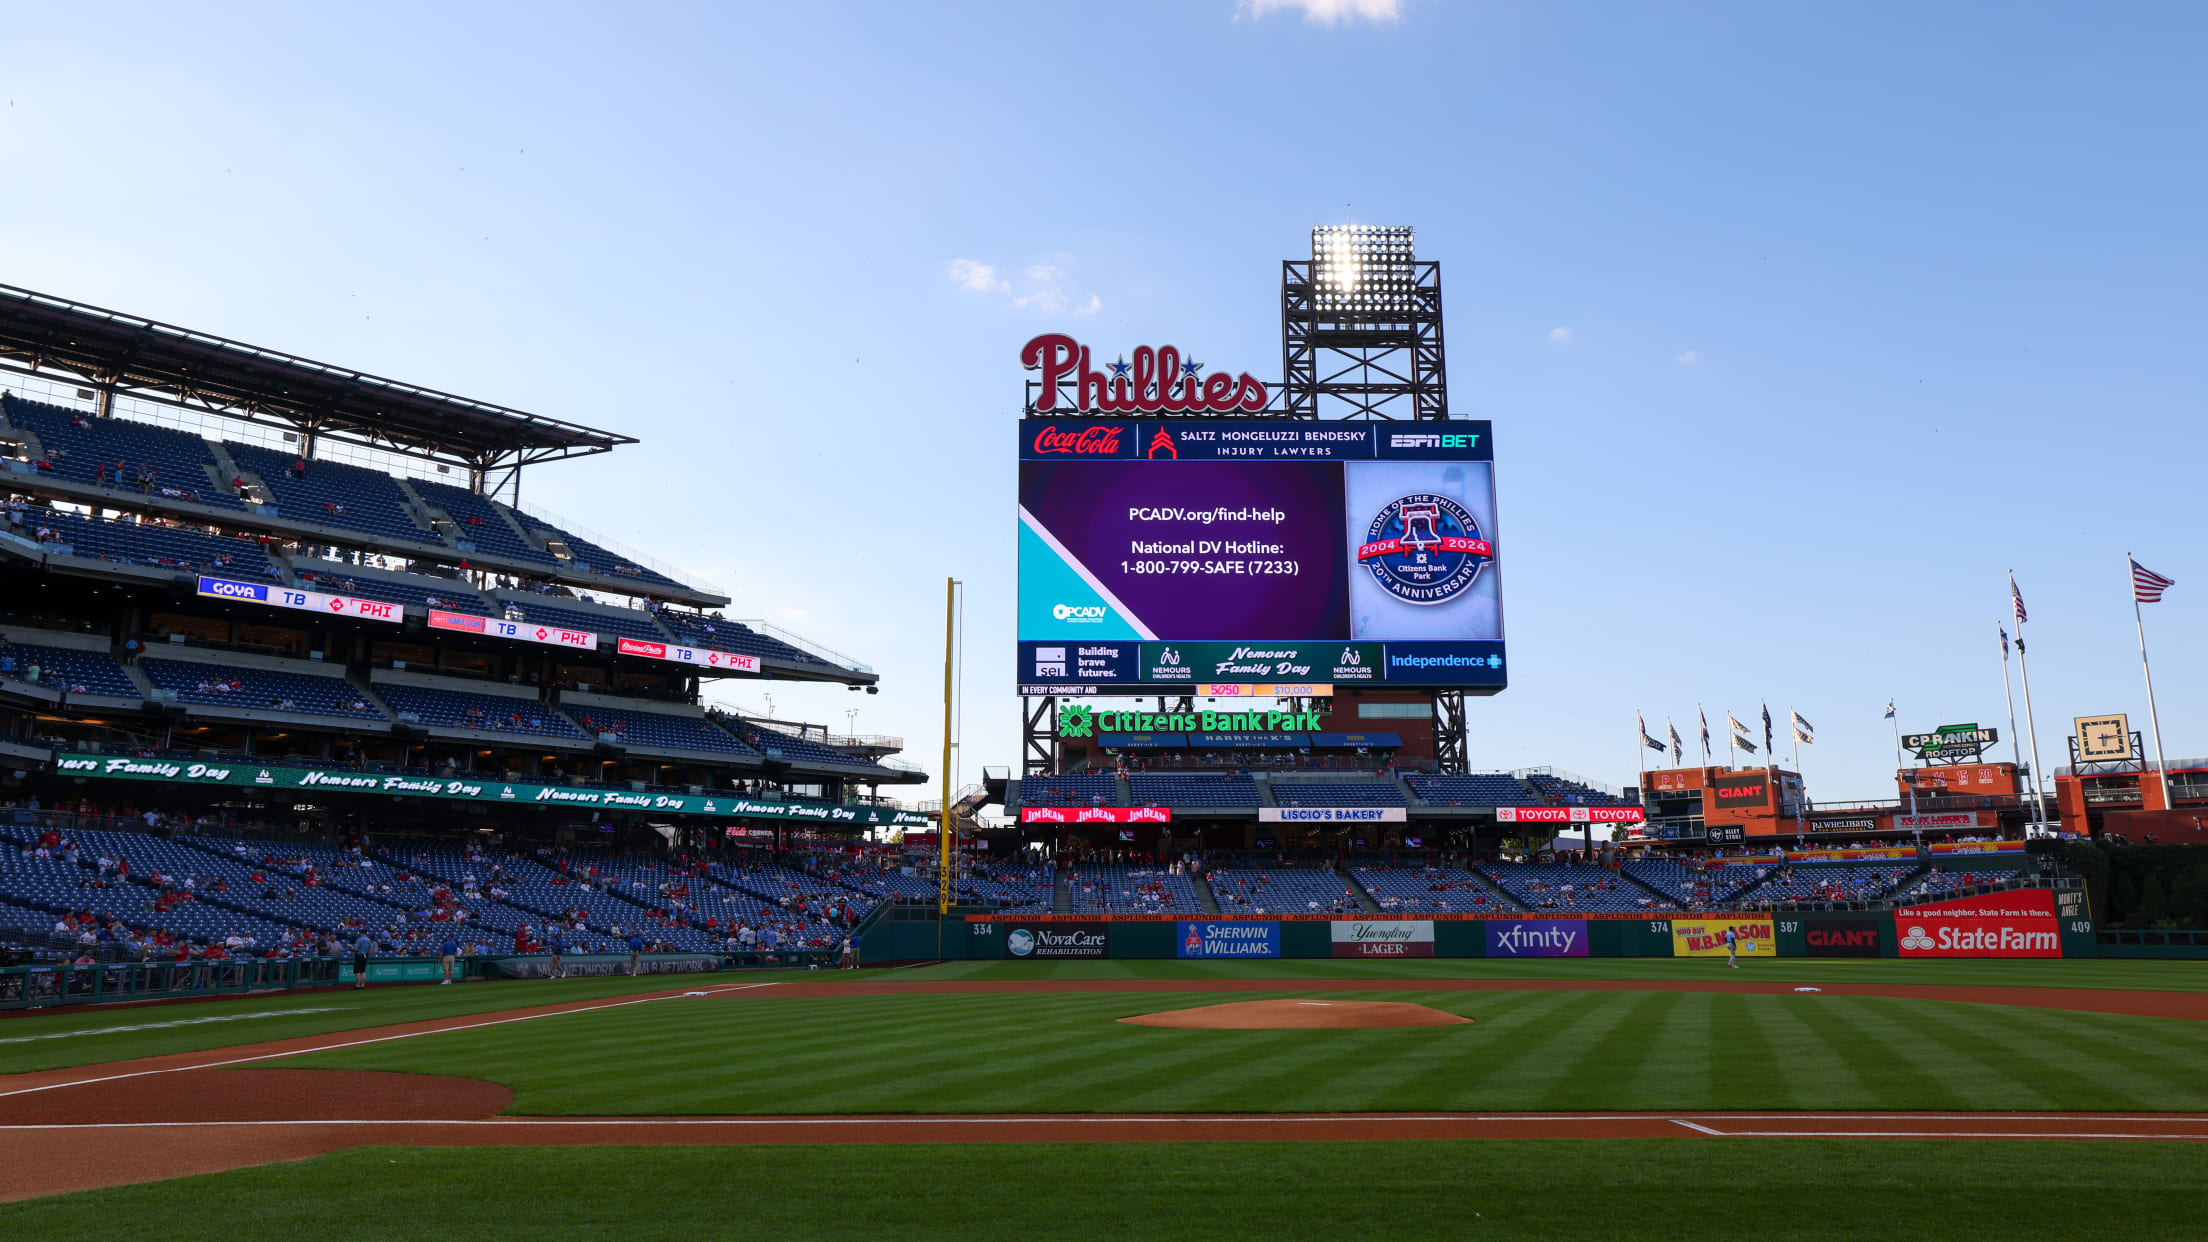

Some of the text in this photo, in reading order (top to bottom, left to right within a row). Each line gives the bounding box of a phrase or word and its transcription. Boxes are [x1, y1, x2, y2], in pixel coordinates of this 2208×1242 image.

[1020, 333, 1268, 415] Phillies
[1034, 426, 1124, 453] Coca-Cola
[1181, 431, 1366, 441] SALTZ MONGELUZZI BENDESKY
[1217, 447, 1331, 456] INJURY LAWYERS
[1129, 507, 1286, 525] PCADV.org/find-help
[1369, 509, 1391, 536] HOME
[1407, 495, 1429, 503] THE
[1432, 496, 1476, 532] PHILLIES
[1131, 540, 1285, 554] National DV Hotline:
[1361, 540, 1396, 555] 2004
[1448, 539, 1487, 552] 2024
[1121, 560, 1300, 577] 1-800-799-SAFE (7233)
[1397, 564, 1447, 572] Citizens Bank
[1391, 560, 1476, 599] ANNIVERSARY
[1413, 572, 1432, 580] Park
[212, 582, 255, 598] GOYA
[284, 591, 306, 606] TB
[359, 602, 392, 618] PHI
[498, 623, 517, 635] TB
[561, 632, 588, 645] PHI
[676, 648, 693, 660] TB
[1078, 647, 1119, 658] Building
[1228, 647, 1298, 661] Nemours
[729, 656, 753, 669] PHI
[1078, 658, 1106, 667] brave
[1392, 654, 1484, 669] Independence
[1216, 662, 1311, 676] Family Day
[1274, 686, 1313, 695] $10,000
[1098, 708, 1322, 733] Citizens Bank Park
[1932, 729, 1990, 745] RANKIN
[1926, 747, 1976, 758] ROOFTOP
[105, 758, 180, 777] Family
[187, 764, 230, 780] Day
[1957, 770, 1968, 780] 15
[1978, 768, 1993, 780] 20
[298, 772, 481, 796] Nemours Family Day
[536, 788, 684, 809] Nemours Family Day
[1718, 785, 1763, 798] GIANT
[732, 801, 856, 821] Nemours Family Day
[1025, 808, 1064, 823] JIM BEAM
[1076, 808, 1115, 823] JIM BEAM
[1127, 808, 1166, 823] JIM BEAM
[1281, 810, 1384, 820] LISCIO'S BAKERY
[1519, 810, 1567, 819] TOYOTA
[1592, 810, 1641, 819] TOYOTA
[1900, 814, 1970, 824] TOY LUKE'S
[1899, 909, 1911, 917] Like
[1923, 909, 1941, 918] good
[1943, 909, 1978, 918] neighbor,
[1979, 909, 1998, 917] State
[2000, 909, 2020, 917] Farm
[2021, 909, 2028, 917] is
[2029, 909, 2052, 917] there.
[2061, 905, 2079, 918] ANGLE
[973, 923, 992, 935] 334
[1205, 925, 1268, 939] SHERWIN
[1351, 923, 1416, 941] Yuengling
[1651, 922, 1669, 933] 374
[1677, 927, 1705, 936] WHO BUT
[1780, 921, 1798, 933] 387
[2071, 921, 2091, 933] 409
[1036, 930, 1105, 946] NovaCare
[1497, 924, 1577, 953] xfinity
[1807, 931, 1878, 946] GIANT
[1204, 940, 1269, 954] WILLIAMS
[1362, 943, 1405, 954] LAGER
[564, 963, 615, 977] NETWORK
[660, 960, 704, 974] NETWORK
